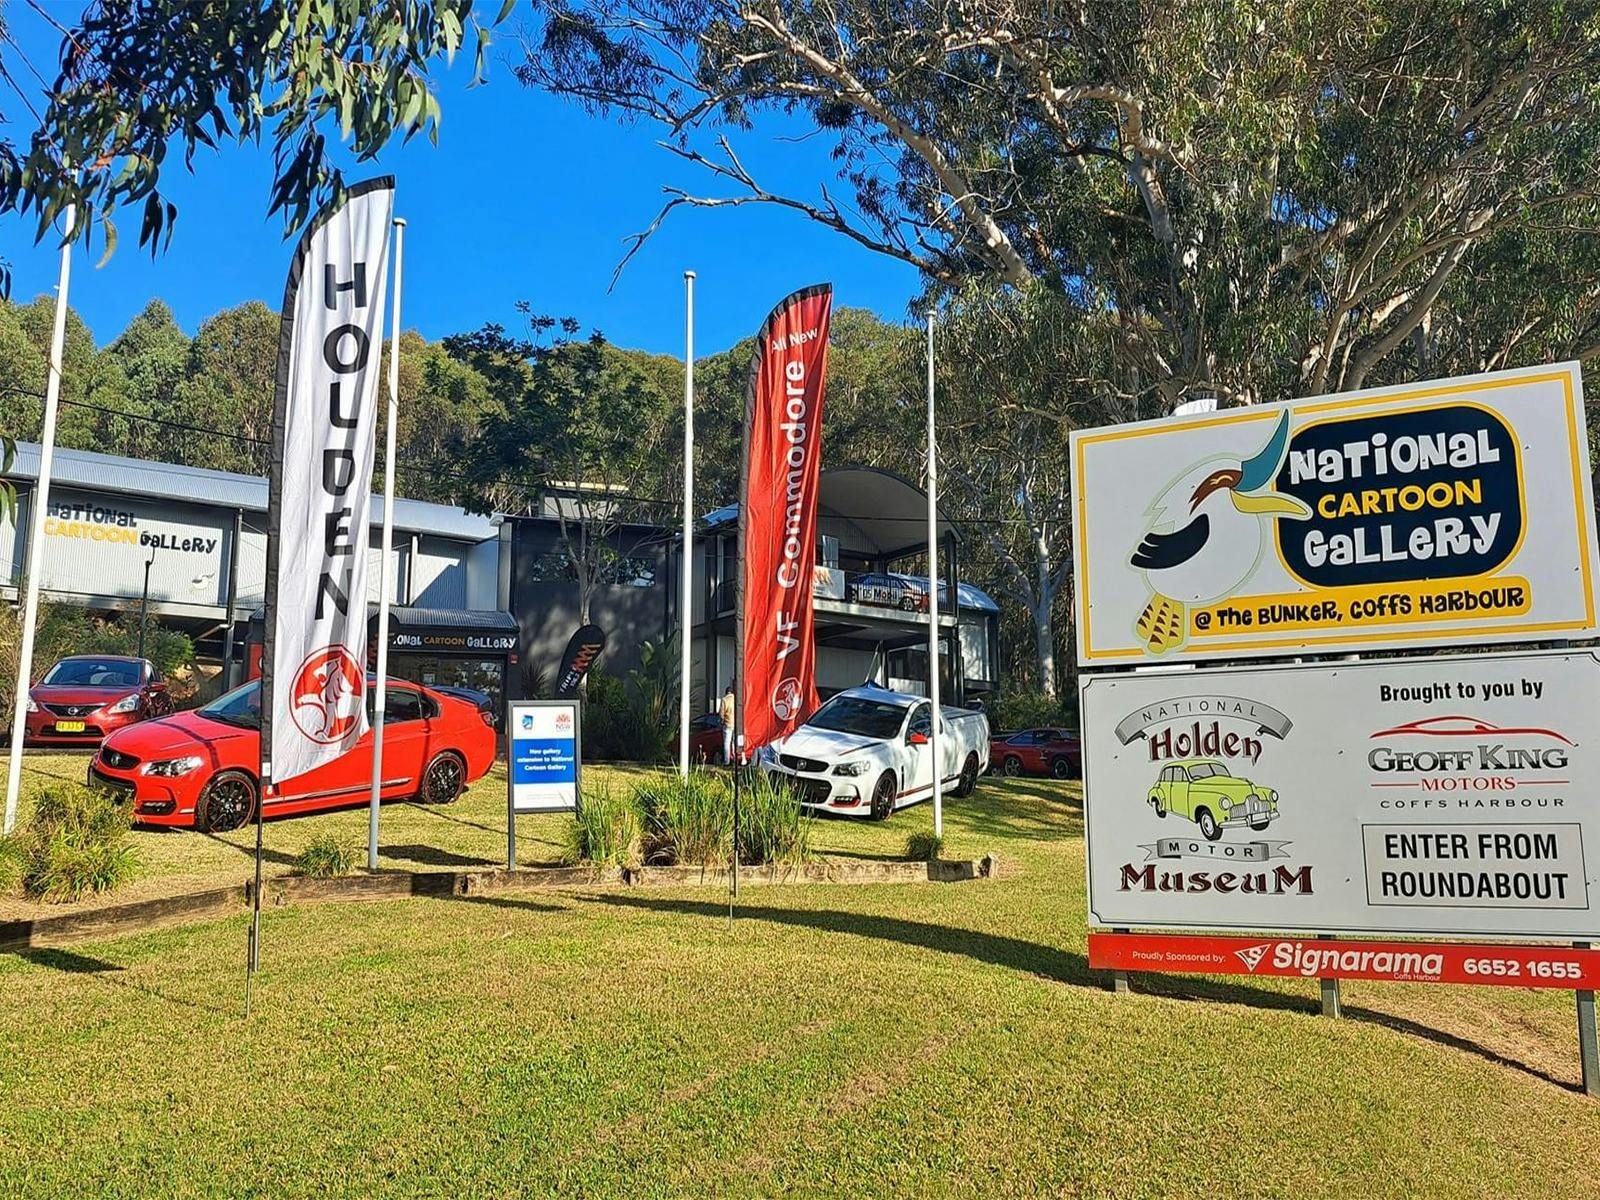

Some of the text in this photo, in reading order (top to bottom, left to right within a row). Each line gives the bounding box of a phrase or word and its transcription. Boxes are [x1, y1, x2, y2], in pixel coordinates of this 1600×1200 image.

[771, 327, 818, 354] All New
[314, 262, 370, 620] HOLDEN
[776, 360, 807, 661] VF Commodore
[1318, 480, 1482, 520] CARTOON
[44, 519, 138, 545] CARTOON
[1195, 612, 1211, 630] @
[424, 636, 465, 646] CARTOON
[1380, 679, 1543, 703] Brought to you by
[1142, 701, 1257, 722] NATIONAL
[543, 748, 561, 756] gallery
[1149, 721, 1262, 766] Holden
[1368, 745, 1568, 772] GEOFF KING
[1421, 776, 1516, 791] MOTORS
[1380, 798, 1564, 809] COFFS HARBOUR
[1169, 842, 1254, 857] MOTOR
[1385, 833, 1558, 860] ENTER FROM
[1382, 872, 1568, 899] ROUNDABOUT
[1132, 951, 1226, 964] Proudly Sponsored by:
[1272, 943, 1444, 975] Signarama
[1463, 958, 1582, 979] 6652 1655
[1393, 972, 1441, 981] Coffs Harbour
